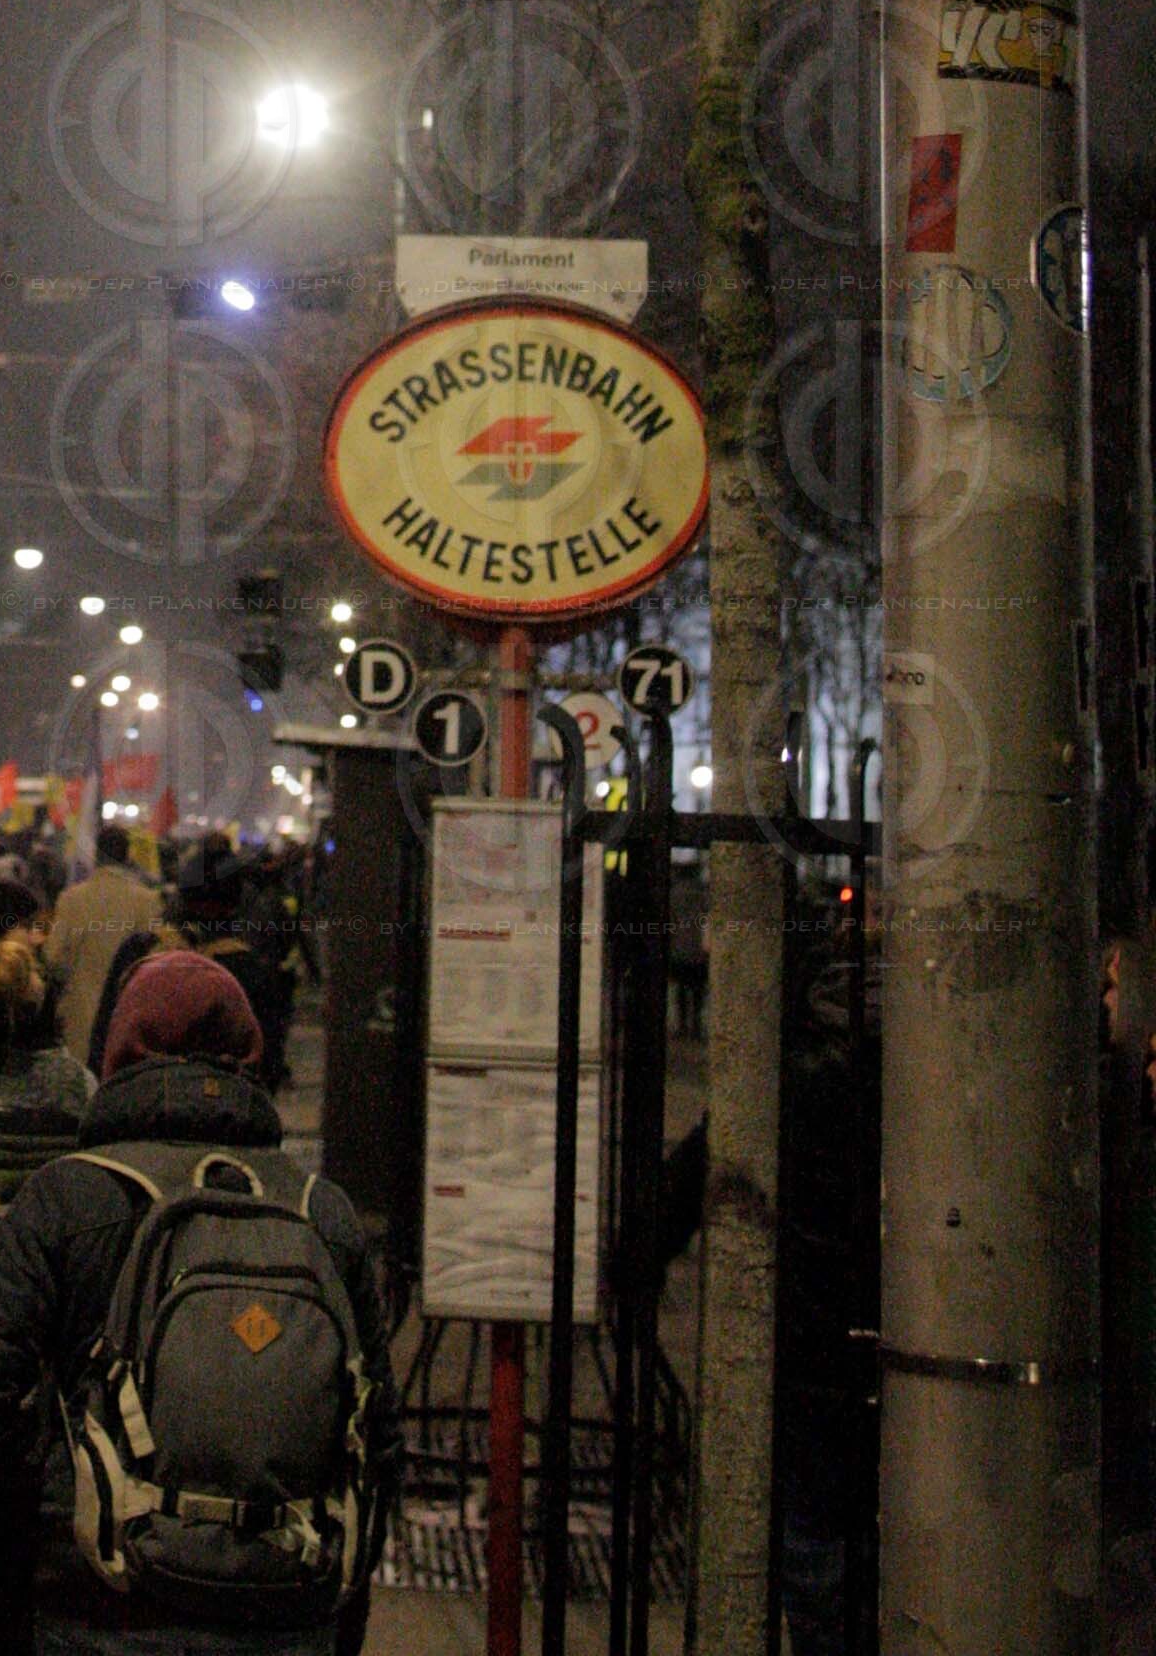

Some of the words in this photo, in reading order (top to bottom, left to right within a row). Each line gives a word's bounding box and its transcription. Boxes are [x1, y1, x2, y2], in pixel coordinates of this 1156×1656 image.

[469, 247, 576, 268] Parlament
[369, 342, 673, 444] STRASSENBAHN
[382, 496, 662, 585] HALTESTELLE
[360, 650, 405, 704] D
[626, 659, 684, 706] 71
[432, 701, 462, 755] 1
[575, 711, 601, 750] 2
